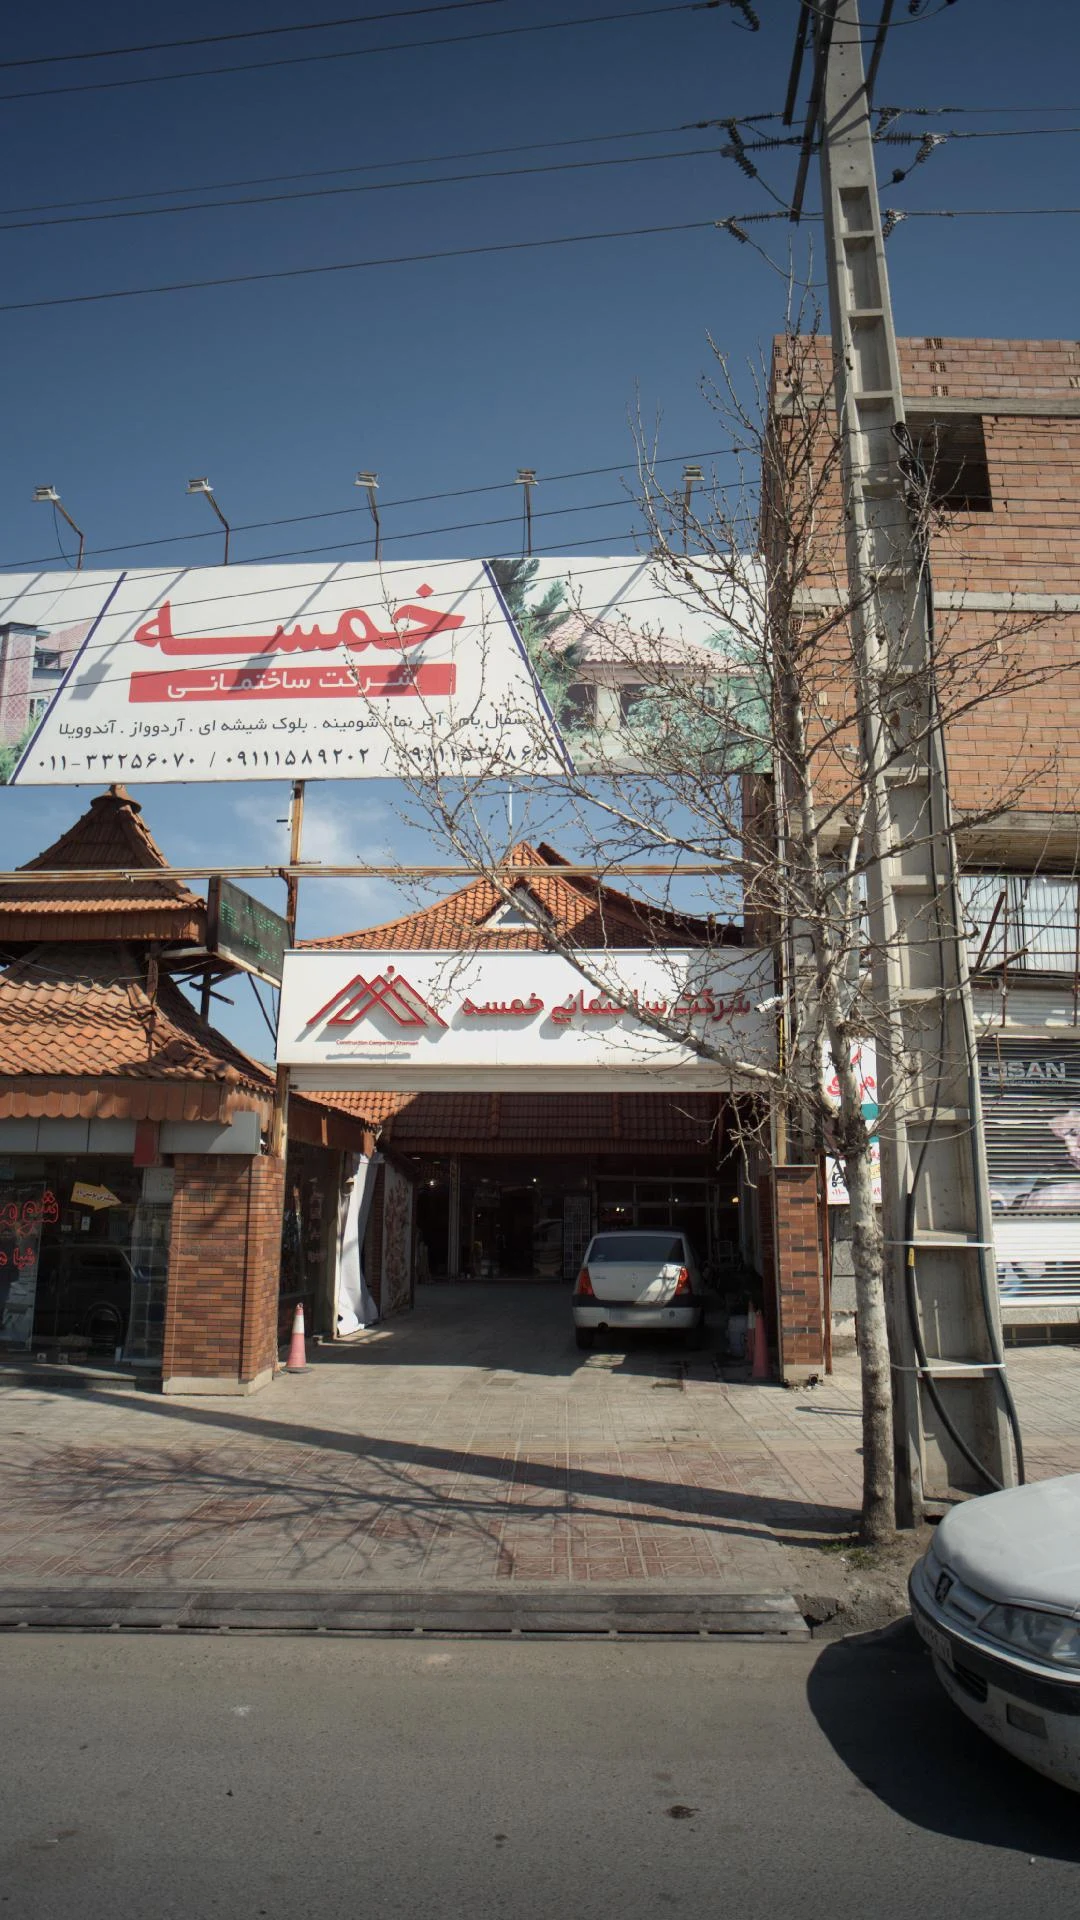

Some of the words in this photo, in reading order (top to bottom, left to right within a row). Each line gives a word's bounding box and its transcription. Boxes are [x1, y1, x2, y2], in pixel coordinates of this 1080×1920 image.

[133, 583, 467, 657] خمسه
[167, 669, 311, 699] ساختمانی
[318, 666, 420, 694] شرکت
[59, 719, 117, 739] آندوویلا
[129, 718, 186, 738] آردوواز
[198, 719, 216, 737] ای
[220, 718, 268, 734] شیشه
[272, 716, 308, 735] بلوک
[323, 716, 379, 732] شومینه
[393, 714, 413, 728] نما
[400, 744, 549, 763] ۰۹۱۱۱۵۲۸۶۵
[462, 992, 545, 1017] خمسه
[552, 988, 668, 1024] ساتمانی
